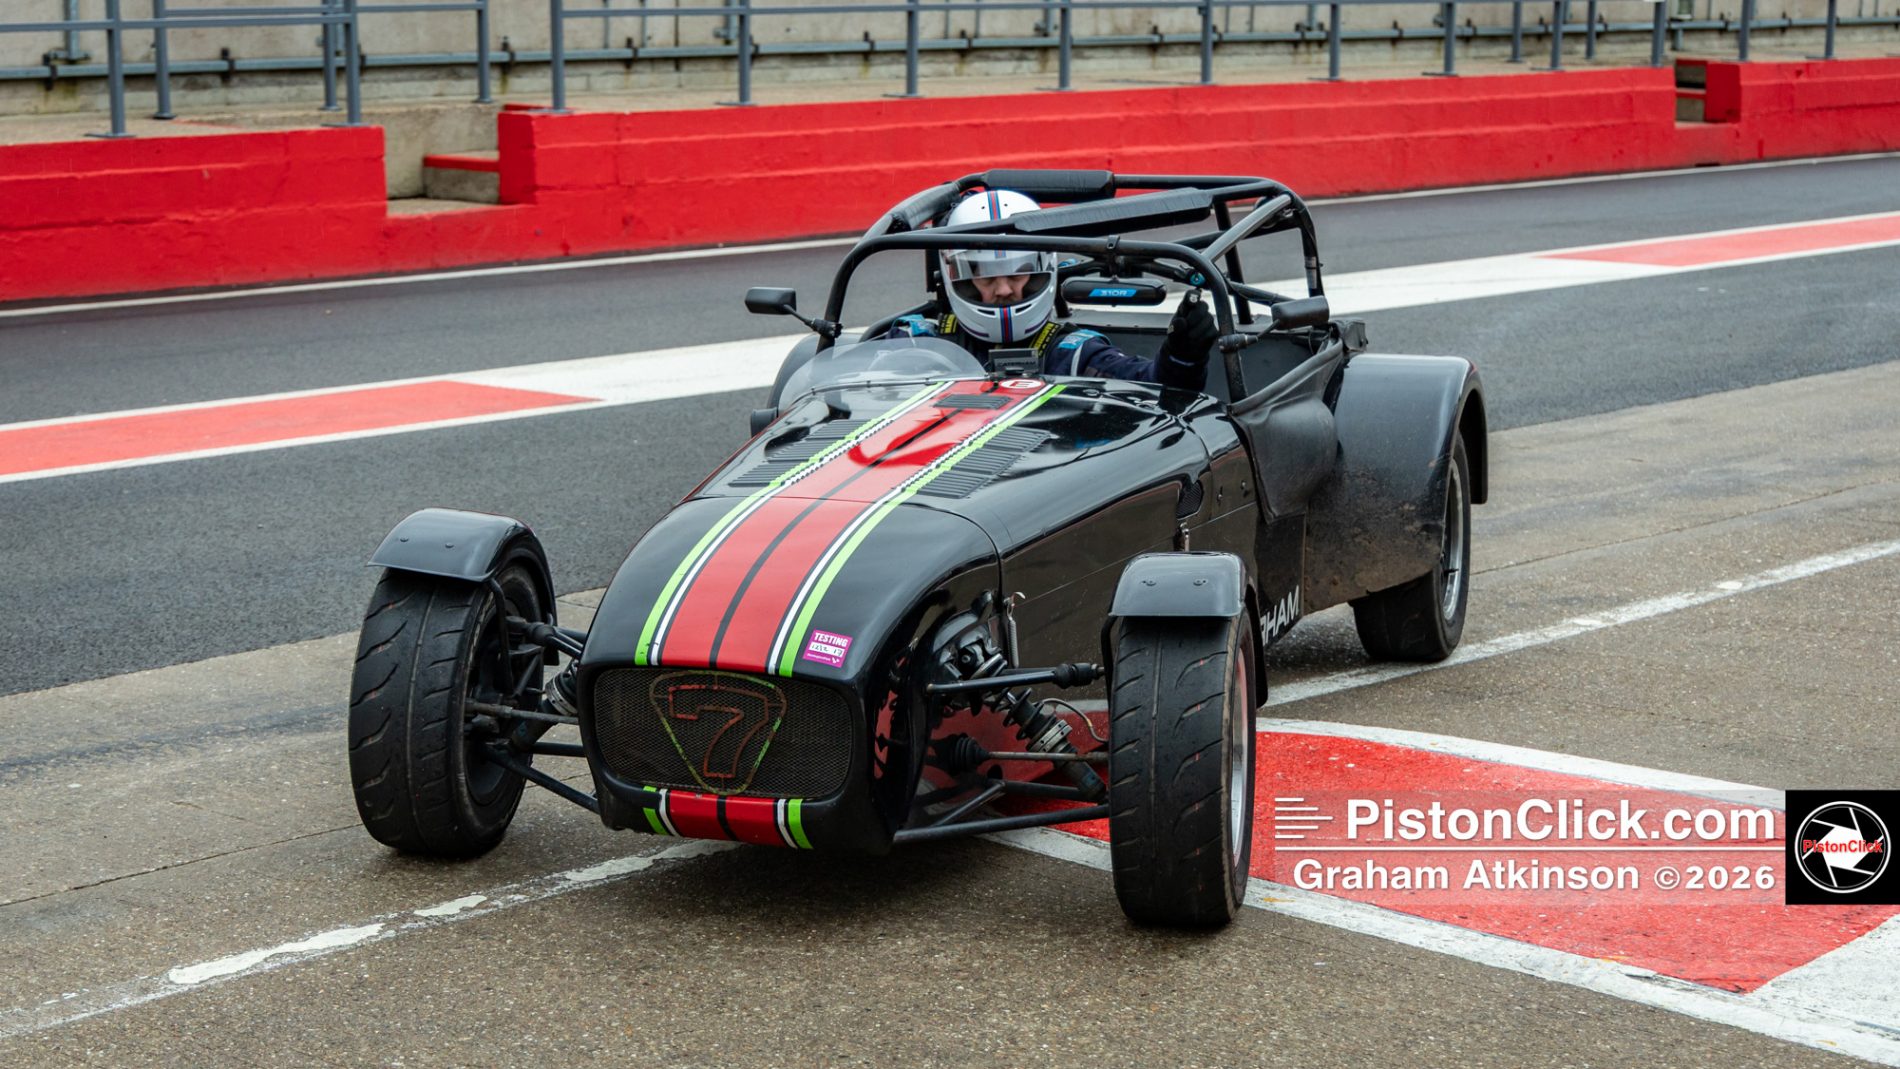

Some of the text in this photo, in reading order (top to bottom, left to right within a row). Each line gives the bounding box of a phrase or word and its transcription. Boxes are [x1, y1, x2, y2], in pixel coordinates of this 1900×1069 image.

[1100, 289, 1128, 297] 310R
[814, 632, 849, 648] TESTING
[668, 684, 770, 778] 7
